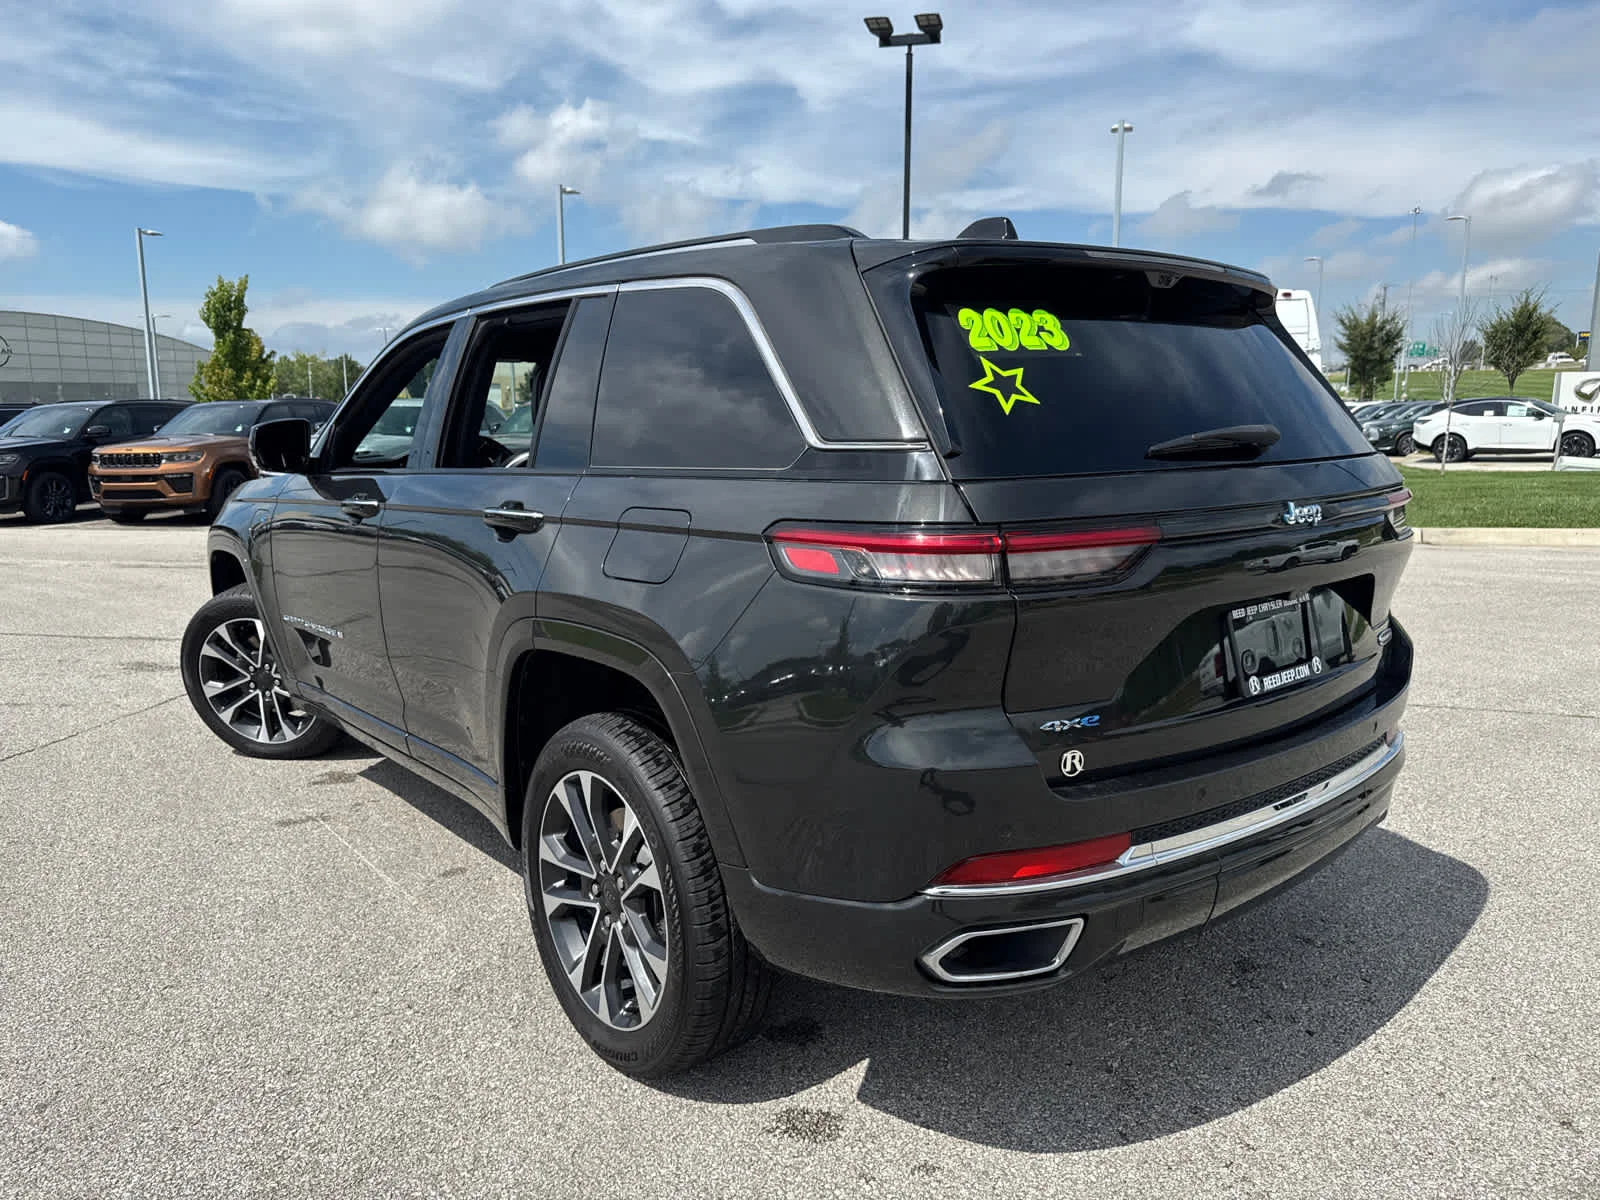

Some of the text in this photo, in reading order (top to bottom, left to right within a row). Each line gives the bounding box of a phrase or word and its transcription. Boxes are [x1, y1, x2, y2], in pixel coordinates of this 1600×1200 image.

[958, 307, 1070, 351] 2023
[1283, 501, 1322, 527] Jeep
[1258, 600, 1283, 613] CHRYSLER
[1263, 664, 1310, 692] REEDJEEP.COM
